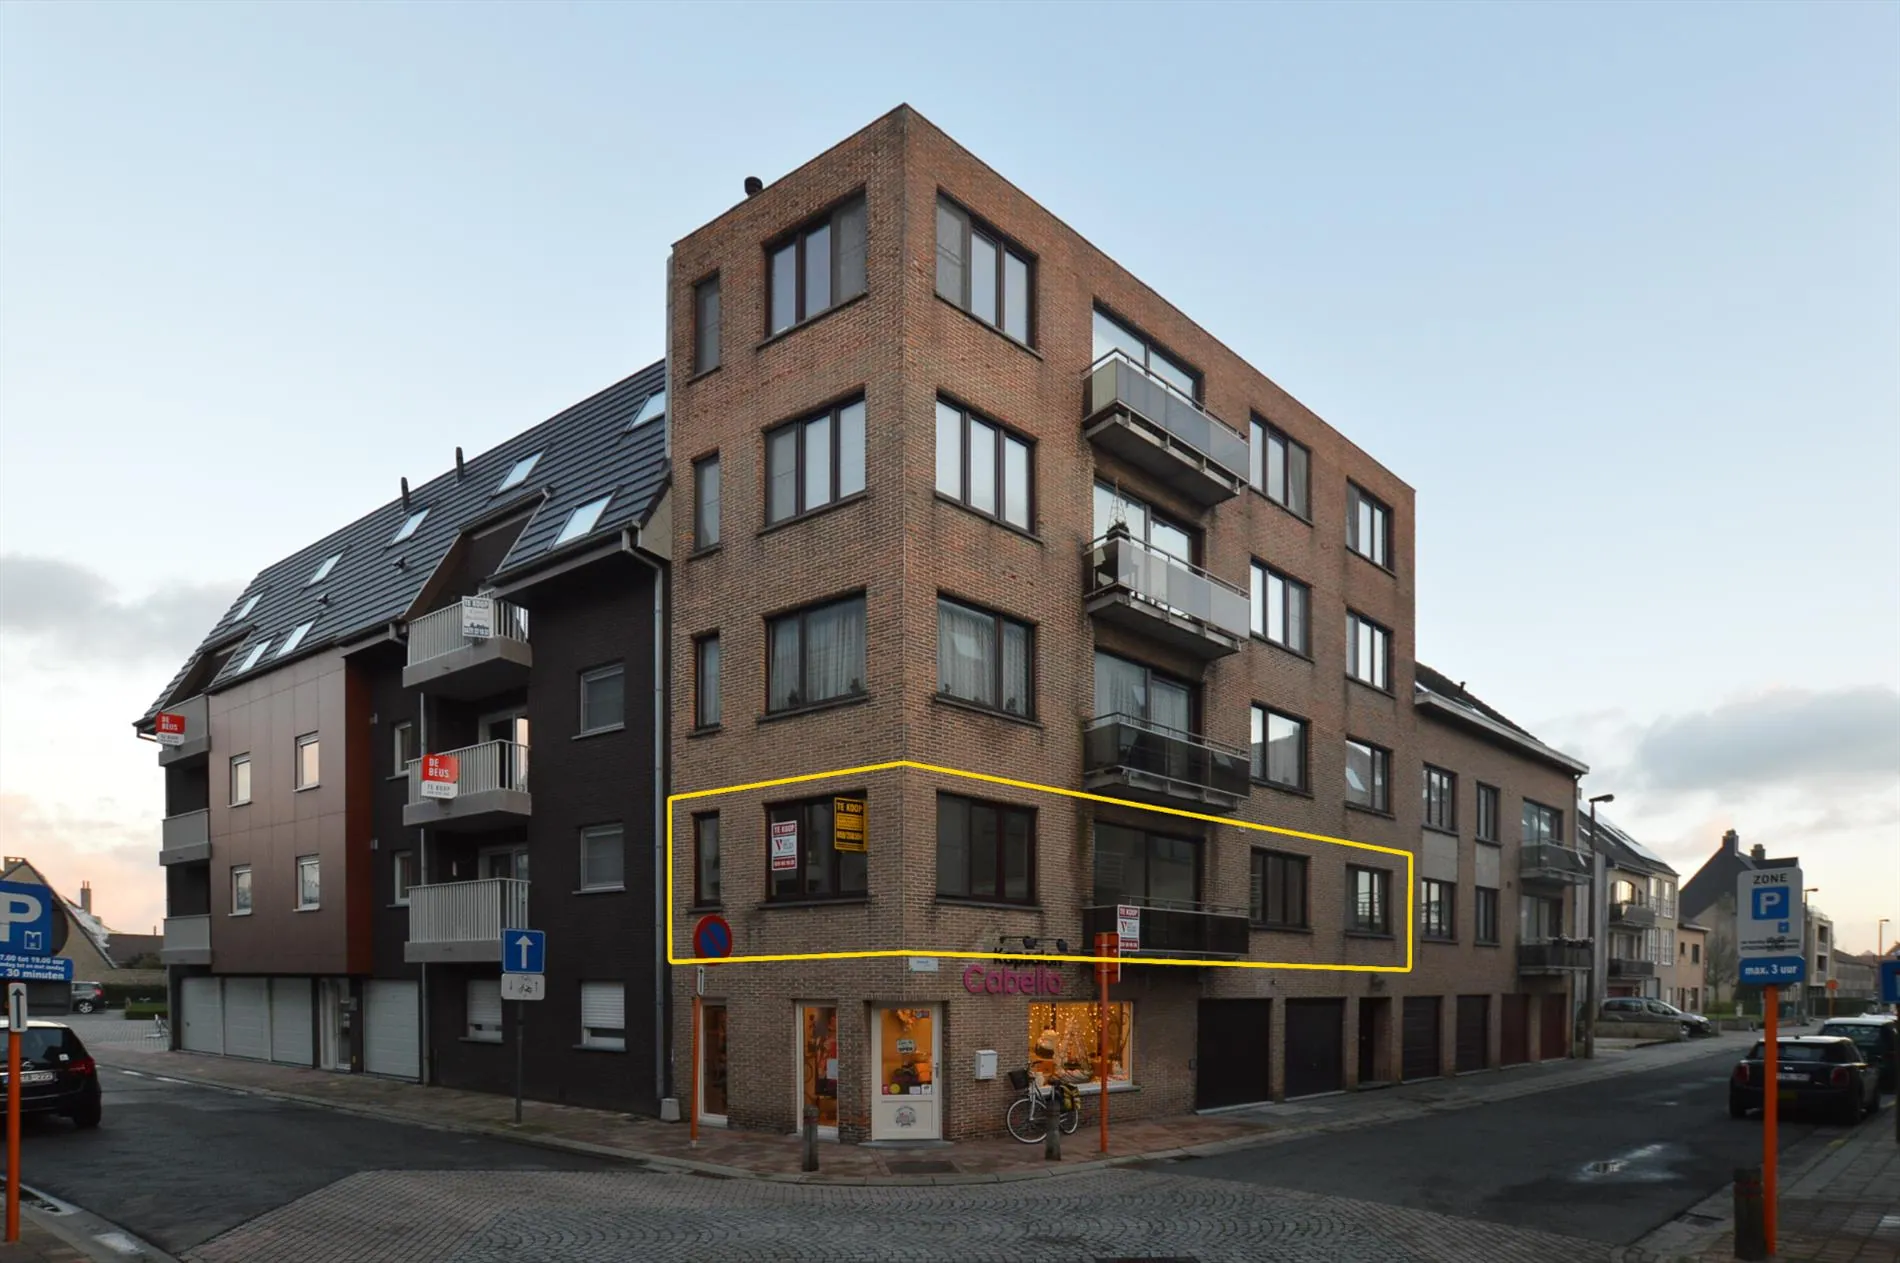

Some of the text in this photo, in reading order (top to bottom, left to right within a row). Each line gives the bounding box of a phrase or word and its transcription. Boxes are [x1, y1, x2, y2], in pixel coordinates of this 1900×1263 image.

[429, 758, 439, 767] DE
[428, 767, 449, 778] BEUS
[837, 802, 863, 813] TE KOOP
[774, 823, 795, 834] TE KOOP
[1753, 873, 1787, 884] ZONE
[1126, 908, 1138, 917] KOOP
[6, 969, 65, 980] 30 minuten
[1745, 964, 1797, 976] max. 3 uur
[963, 964, 1062, 996] Cabello
